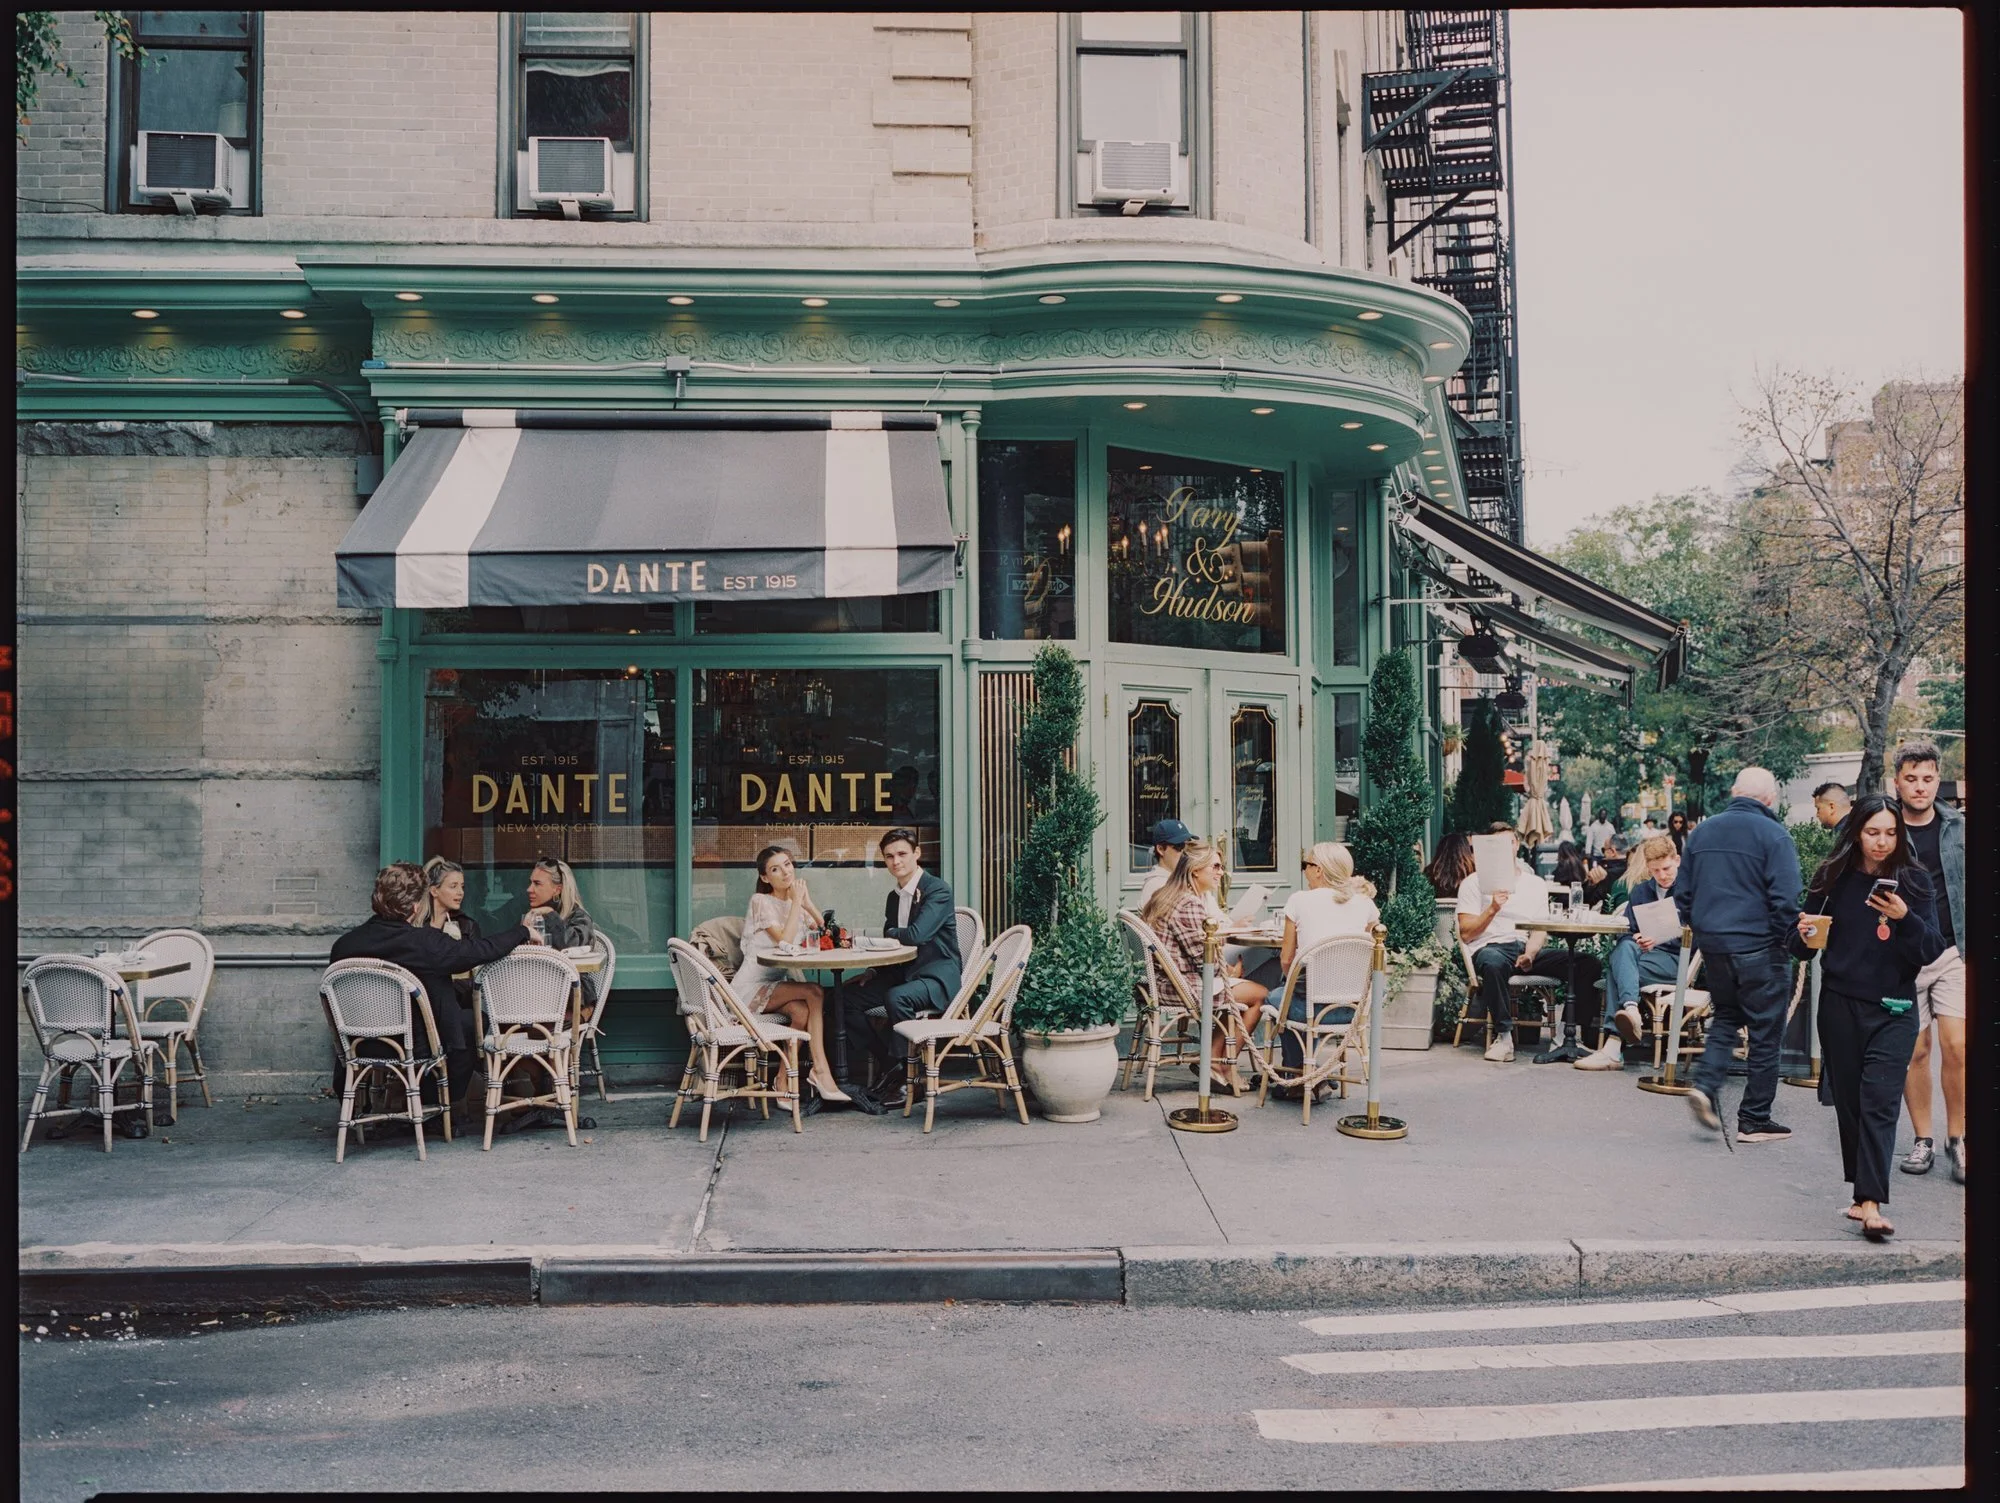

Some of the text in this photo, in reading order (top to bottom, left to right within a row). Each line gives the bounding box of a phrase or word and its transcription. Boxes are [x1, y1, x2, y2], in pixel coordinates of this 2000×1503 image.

[1156, 486, 1239, 552] Perry
[587, 560, 797, 593] DANTE EST 1915
[1186, 536, 1225, 584] &
[1140, 576, 1256, 624] Hudson
[554, 755, 579, 765] 1915
[820, 754, 845, 765] 1915
[472, 774, 627, 814] DANTE
[741, 773, 893, 812] DANTE
[497, 823, 603, 833] NEW YORK CITY
[766, 822, 870, 832] NEW YORK CITY
